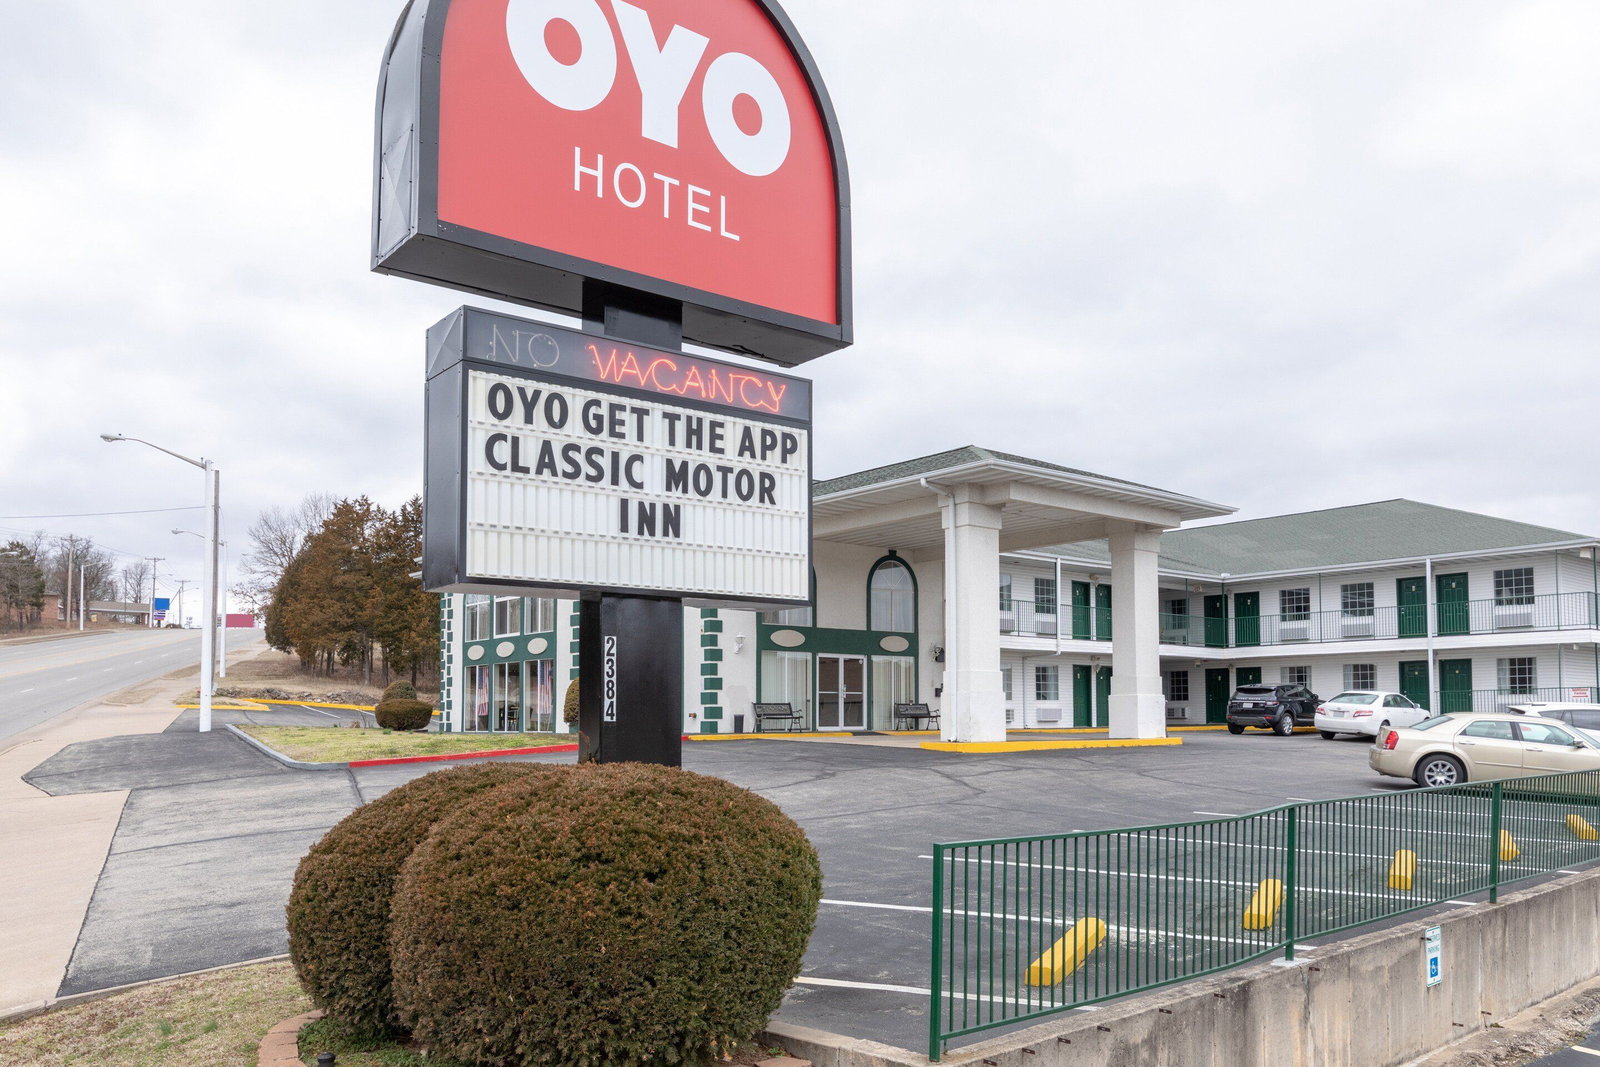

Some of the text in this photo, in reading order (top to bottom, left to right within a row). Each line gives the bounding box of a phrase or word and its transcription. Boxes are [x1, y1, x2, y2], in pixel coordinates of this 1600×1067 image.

[506, 0, 791, 177] OYO
[574, 146, 740, 242] HOTEL
[486, 323, 787, 413] NO VACANCY
[487, 382, 799, 464] OYO GET THE APP
[484, 432, 777, 505] CLASSIC MOTOR
[619, 497, 682, 539] INN
[605, 636, 616, 721] 2384
